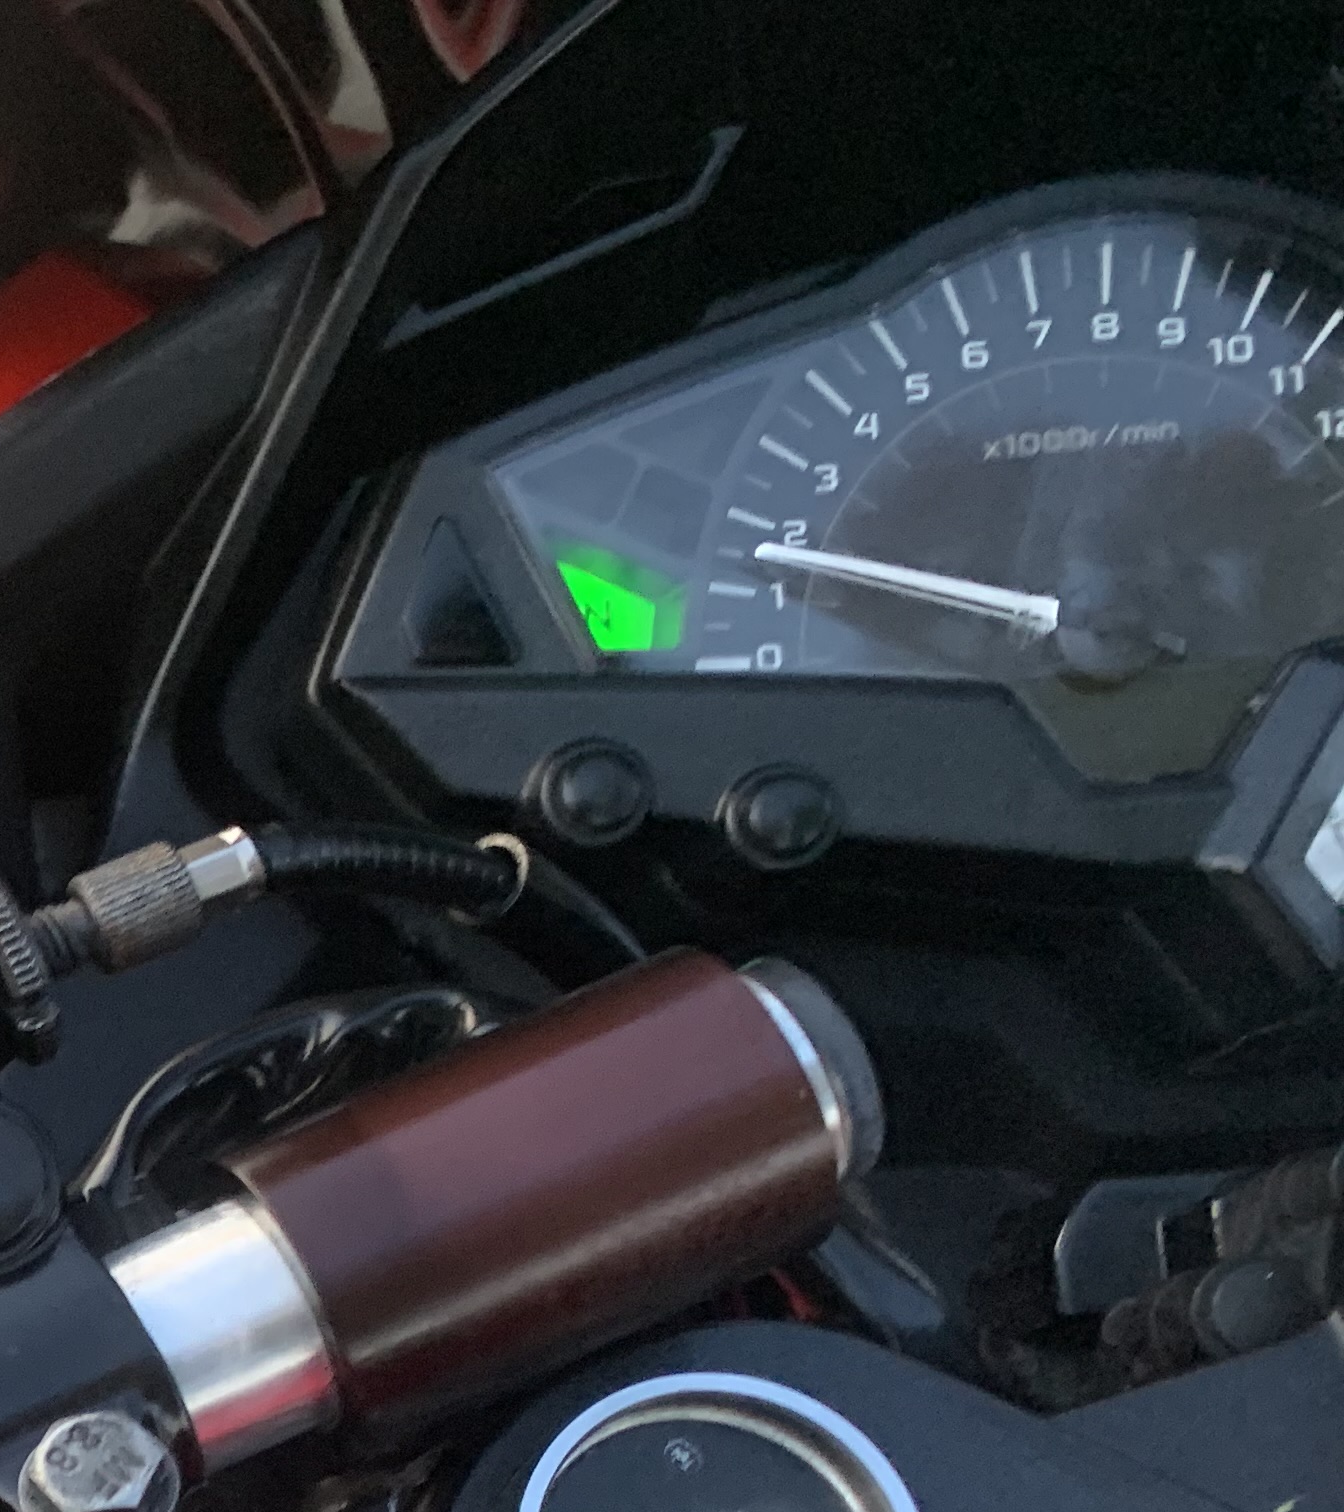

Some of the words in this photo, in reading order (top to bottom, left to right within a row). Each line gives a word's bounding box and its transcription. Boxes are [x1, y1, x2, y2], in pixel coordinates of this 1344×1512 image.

[1025, 319, 1052, 349] 7
[1092, 312, 1120, 341] 8
[1158, 317, 1186, 348] 9
[962, 340, 989, 369] 6
[1207, 333, 1254, 365] 10
[905, 372, 930, 404] 5
[1268, 364, 1305, 395] 11
[853, 412, 879, 440] 4
[814, 463, 839, 494] 3
[782, 519, 808, 546] 2
[769, 581, 784, 610] 1
[756, 643, 783, 671] 0
